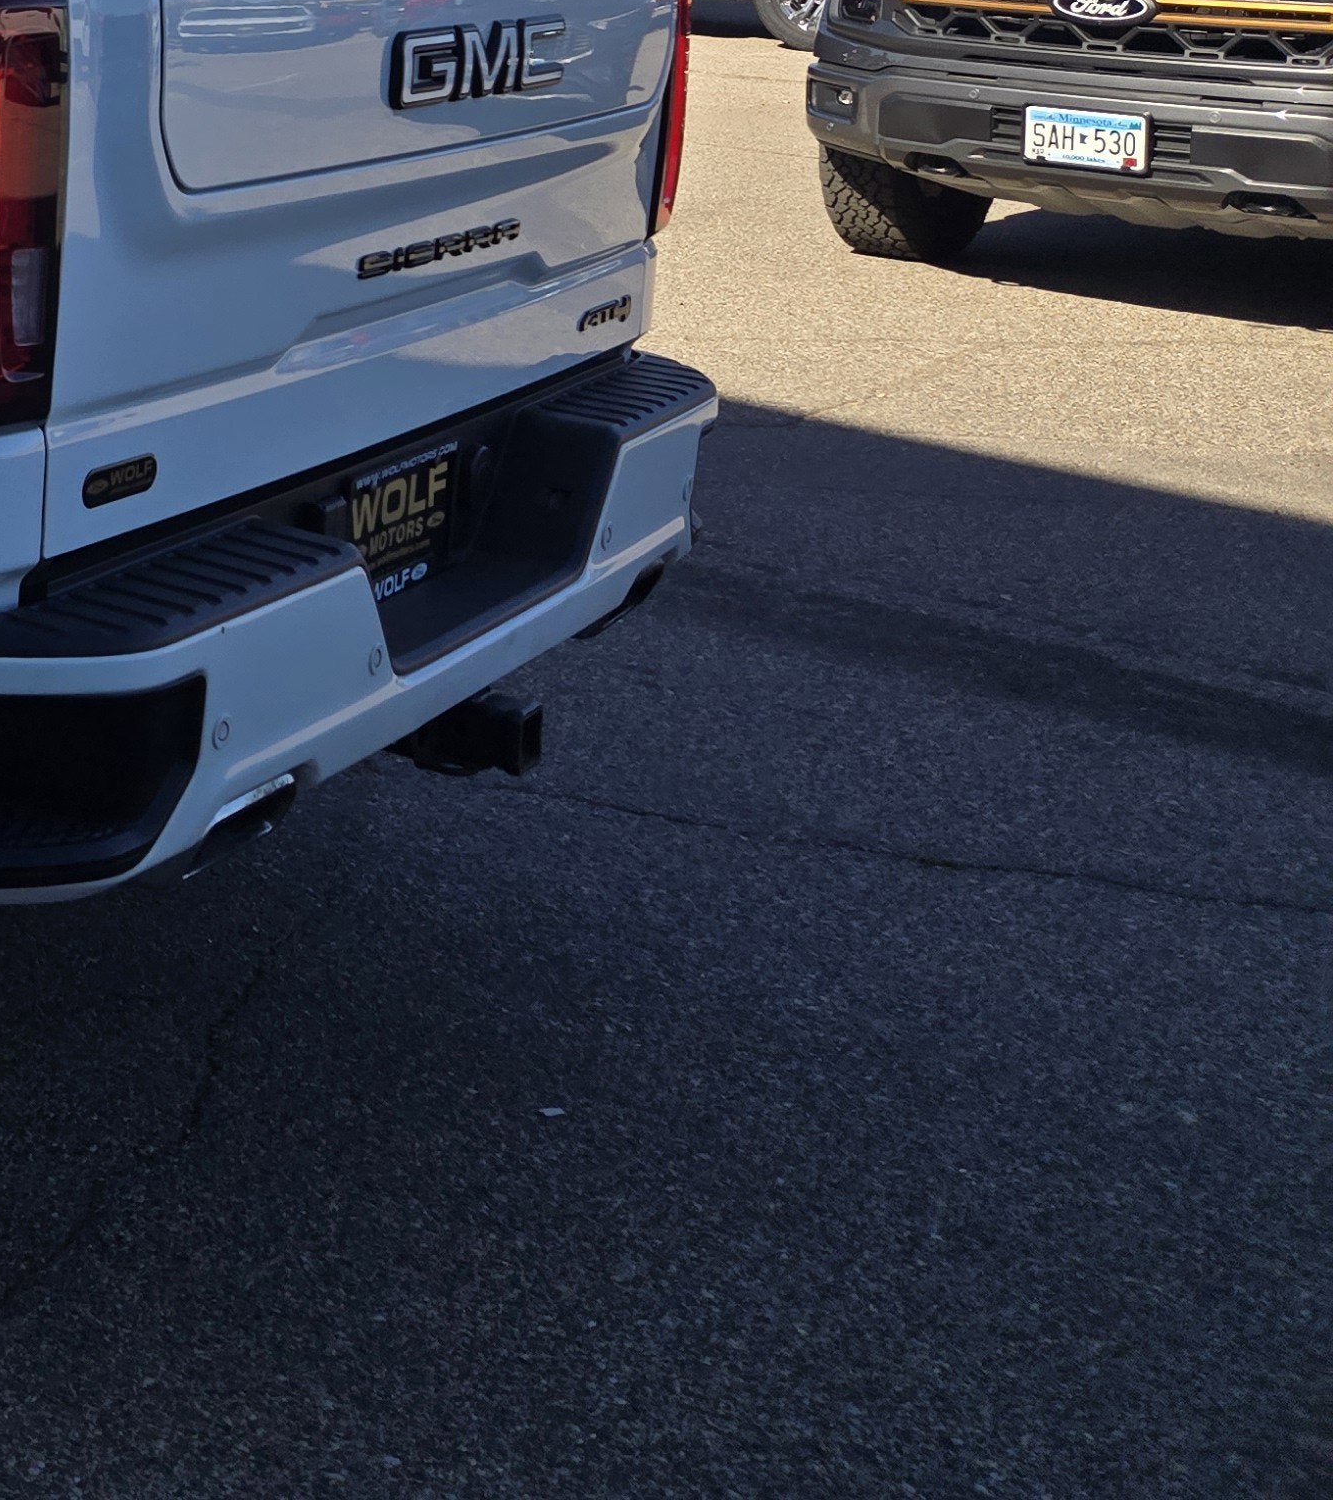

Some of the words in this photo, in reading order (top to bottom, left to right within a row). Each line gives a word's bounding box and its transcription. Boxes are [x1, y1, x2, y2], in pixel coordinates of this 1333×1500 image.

[388, 13, 566, 110] GMC
[1033, 122, 1075, 150] SAH
[1094, 128, 1136, 156] 530
[1058, 113, 1112, 126] Minnesota
[357, 217, 521, 280] SIERRA
[110, 460, 153, 486] WOLF
[352, 461, 448, 540] WOLF
[369, 516, 424, 556] MOTORS
